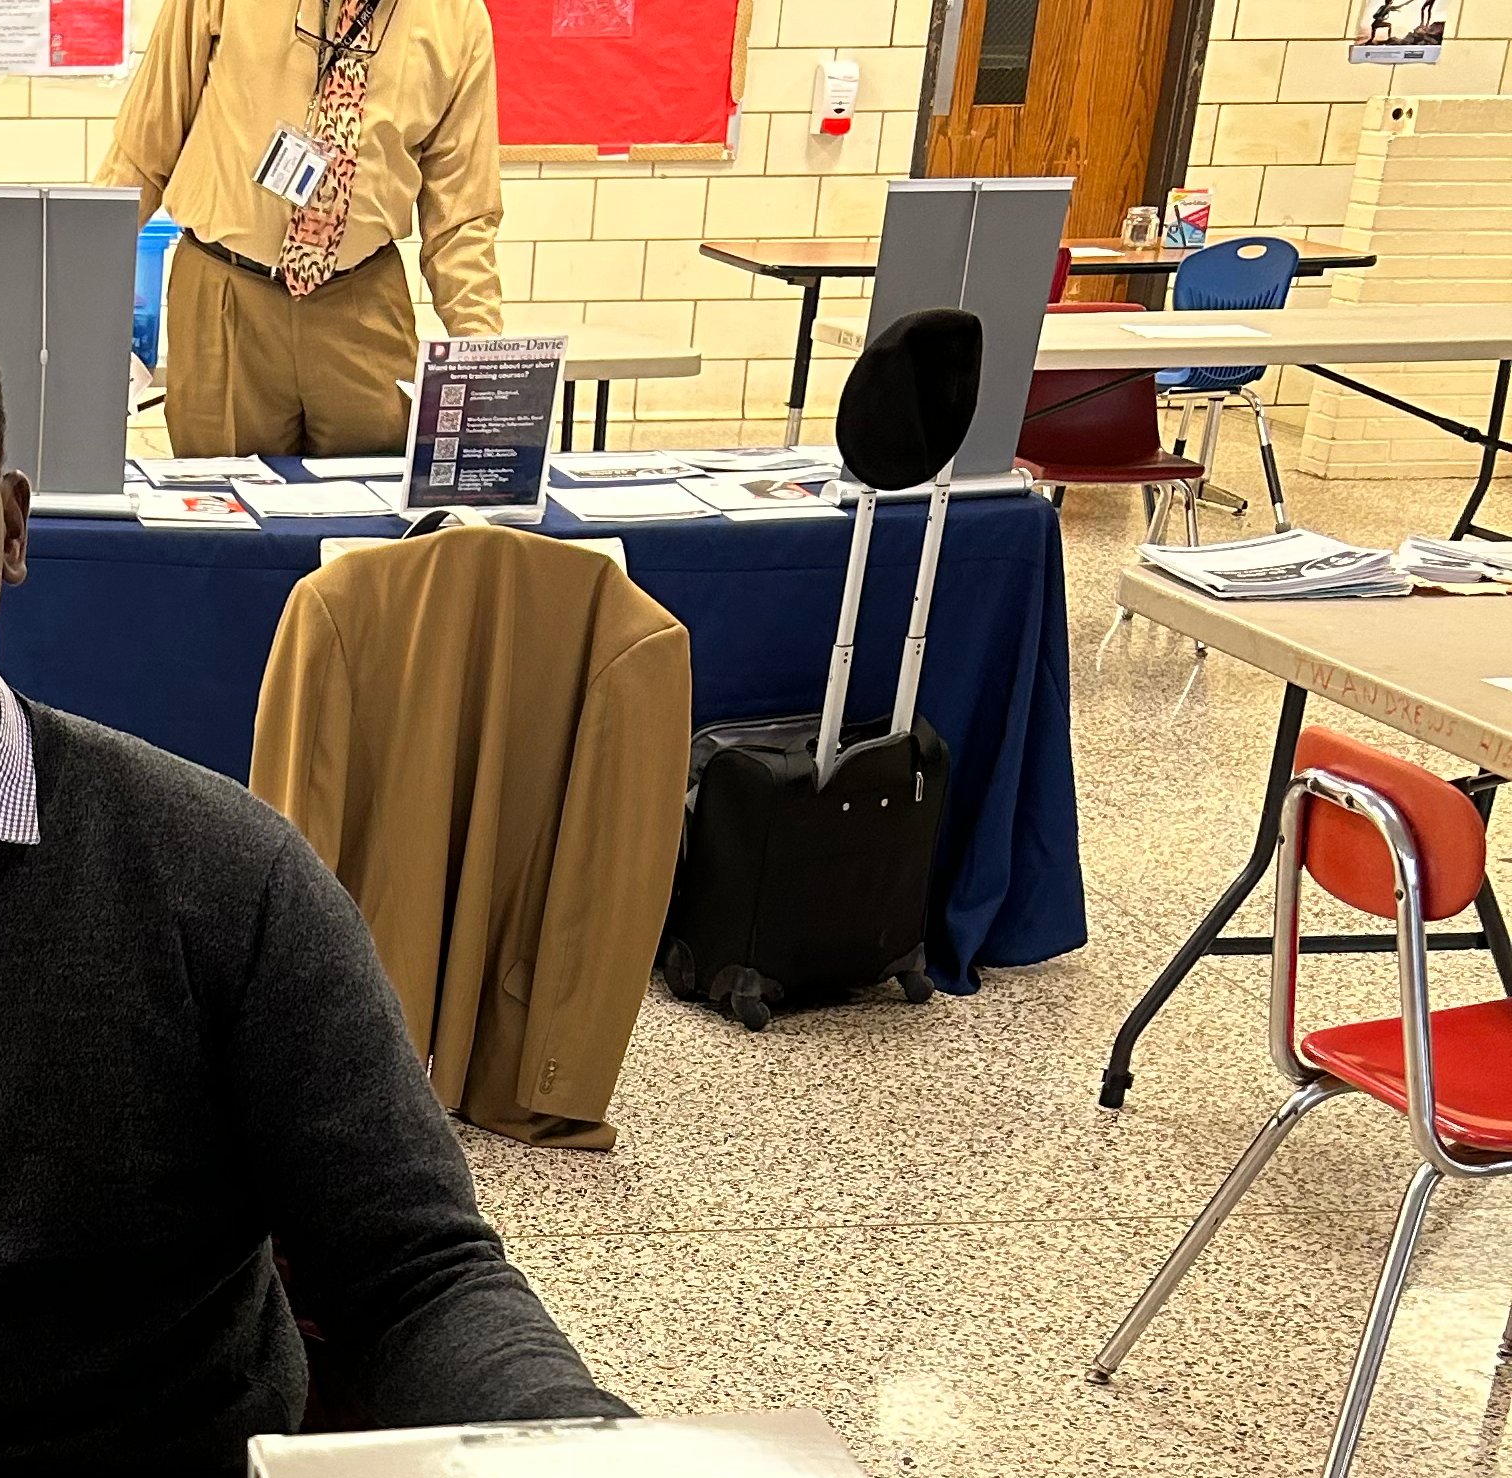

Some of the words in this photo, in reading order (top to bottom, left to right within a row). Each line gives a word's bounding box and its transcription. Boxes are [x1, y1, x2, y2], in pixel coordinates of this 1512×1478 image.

[458, 338, 564, 353] Davidson-Davie
[428, 363, 448, 371] Want
[457, 363, 478, 371] know
[499, 362, 520, 370] about
[535, 361, 554, 369] short
[469, 372, 497, 381] training
[498, 371, 529, 379] courses?
[1293, 657, 1336, 693] TW
